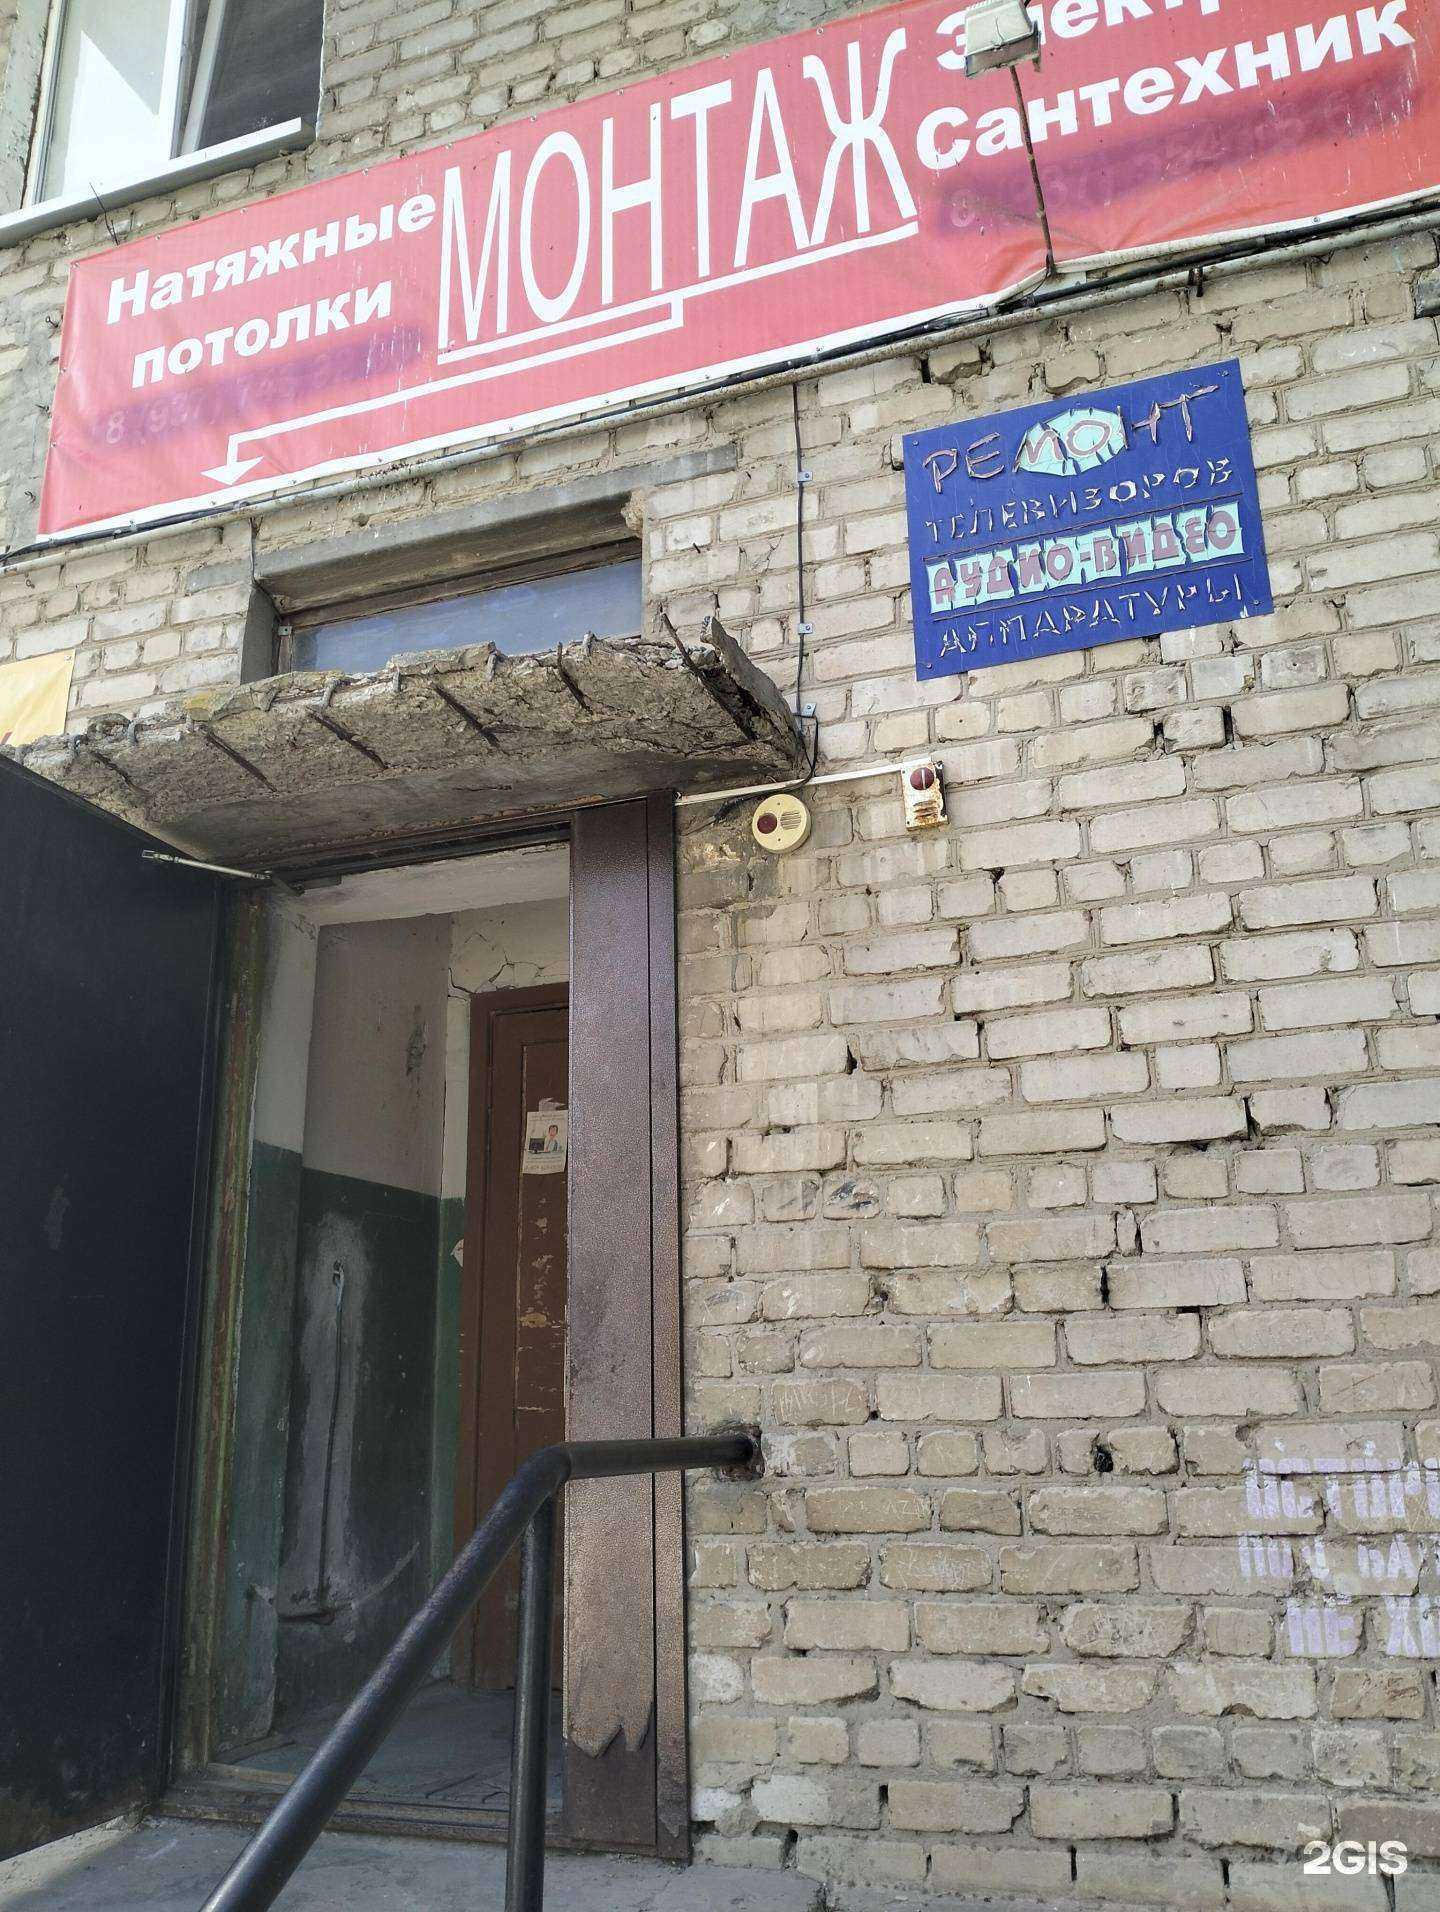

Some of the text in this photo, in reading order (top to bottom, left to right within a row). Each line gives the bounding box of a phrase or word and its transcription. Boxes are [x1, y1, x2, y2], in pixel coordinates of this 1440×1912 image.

[916, 0, 1416, 169] Сантехник
[438, 28, 917, 349] МОНТАЖ
[107, 193, 436, 325] Натяжные
[132, 280, 392, 388] потолки
[922, 385, 1219, 493] РЕМОНТ
[932, 509, 1238, 607] АУДИО-ВИДЕО
